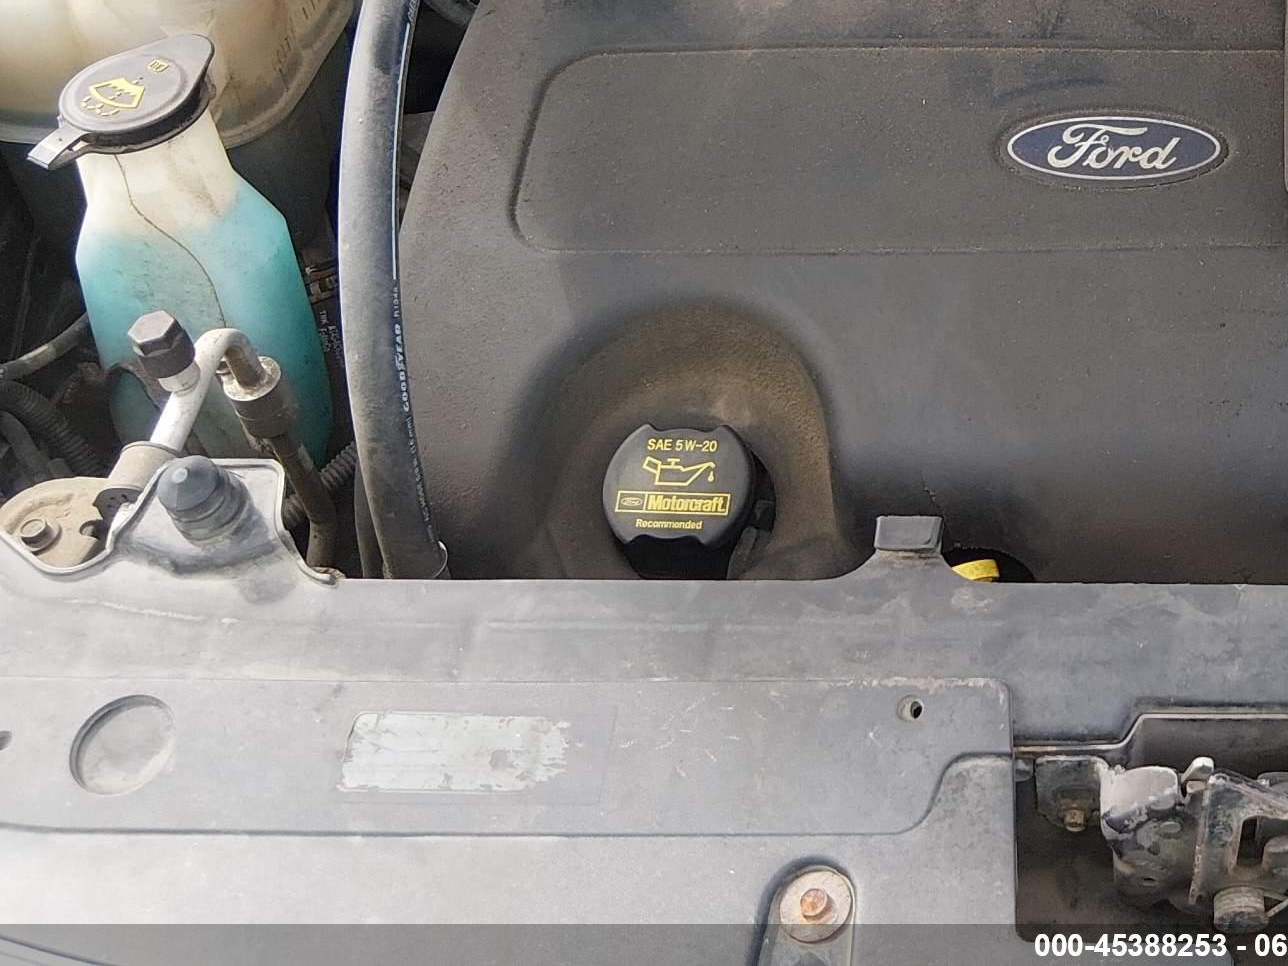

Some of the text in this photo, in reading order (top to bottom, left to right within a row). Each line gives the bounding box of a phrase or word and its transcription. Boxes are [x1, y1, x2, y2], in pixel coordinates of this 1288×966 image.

[1047, 123, 1181, 170] Ford
[395, 324, 410, 412] GOODYEAR
[647, 439, 673, 451] SAE
[635, 518, 703, 530] Recommended
